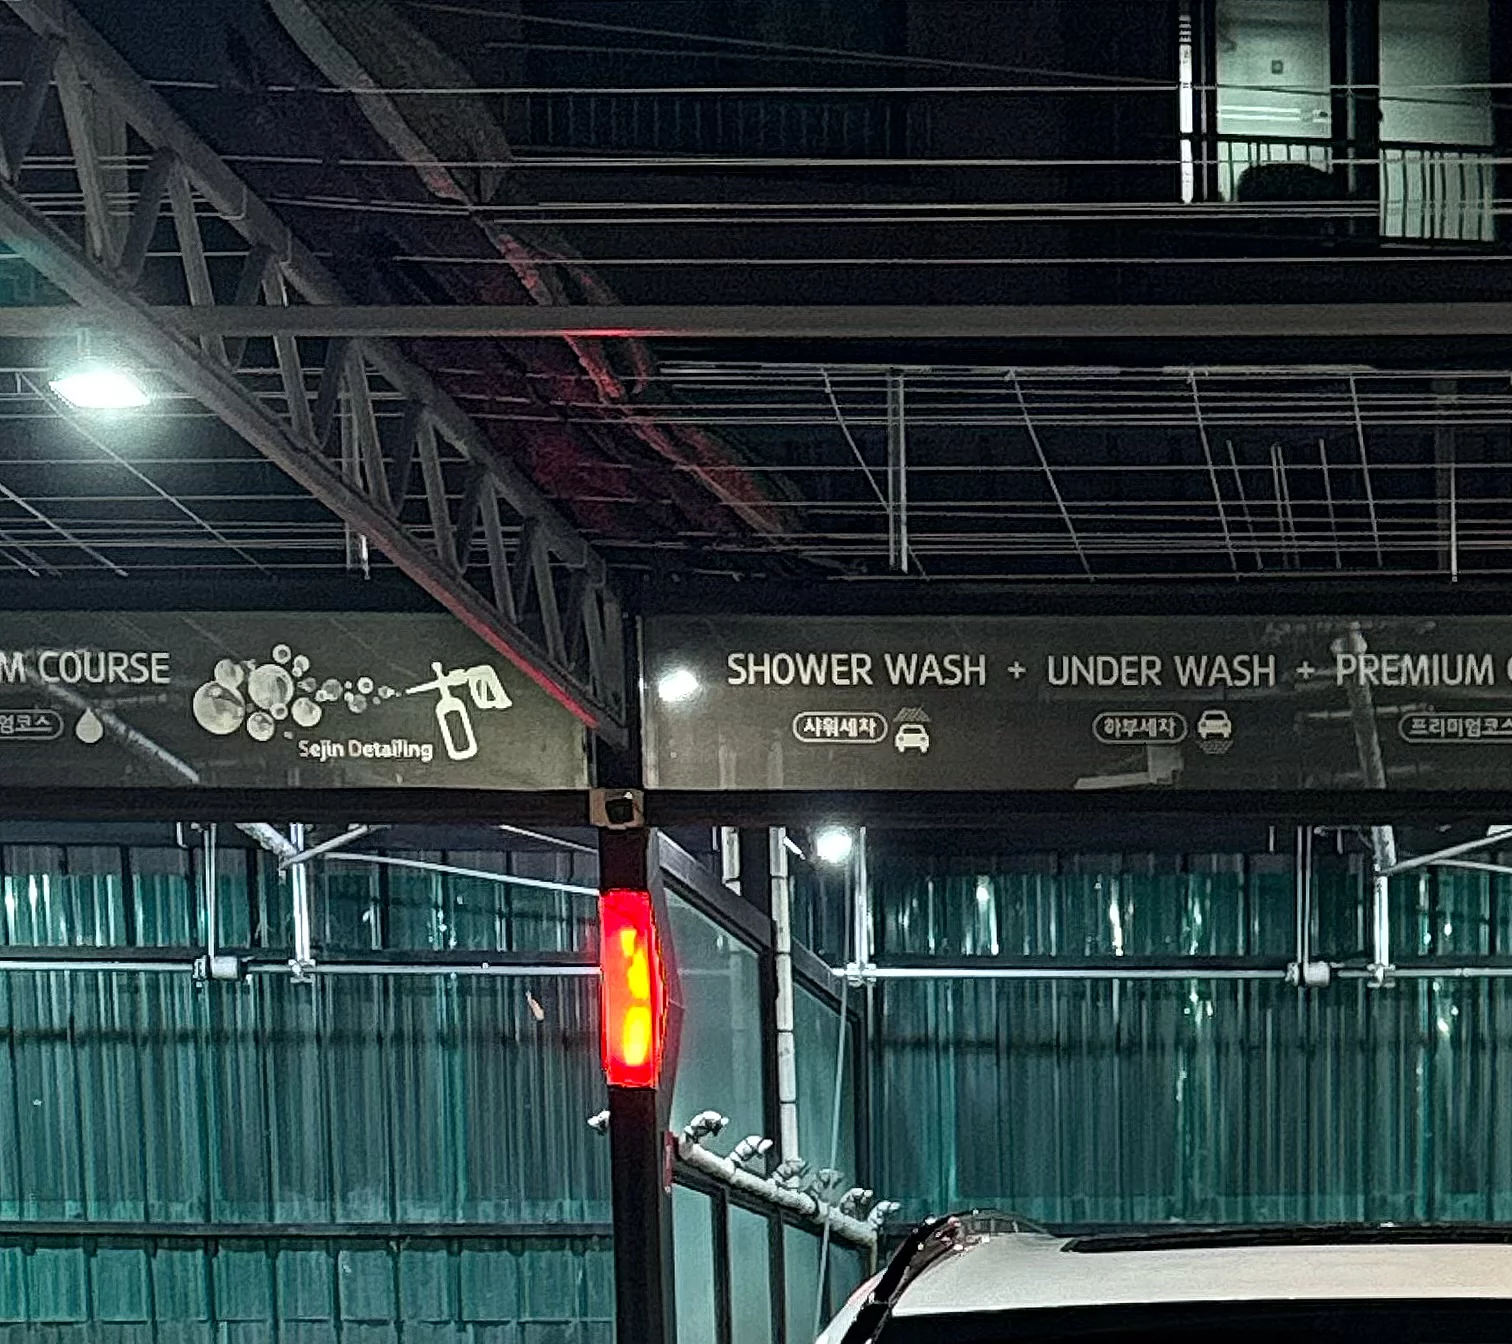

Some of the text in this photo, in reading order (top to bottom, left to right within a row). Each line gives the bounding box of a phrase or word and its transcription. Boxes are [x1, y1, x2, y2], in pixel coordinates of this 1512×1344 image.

[38, 651, 171, 684] COURSE
[727, 653, 873, 685] SHOWER
[884, 653, 986, 686] WASH
[1048, 655, 1162, 686] UNDER
[1173, 654, 1275, 687] WASH
[1336, 653, 1494, 686] PREMIUM
[803, 716, 878, 738] 샤워세차
[1103, 716, 1177, 738] 하부세차
[299, 738, 433, 762] Sejin Detailing
